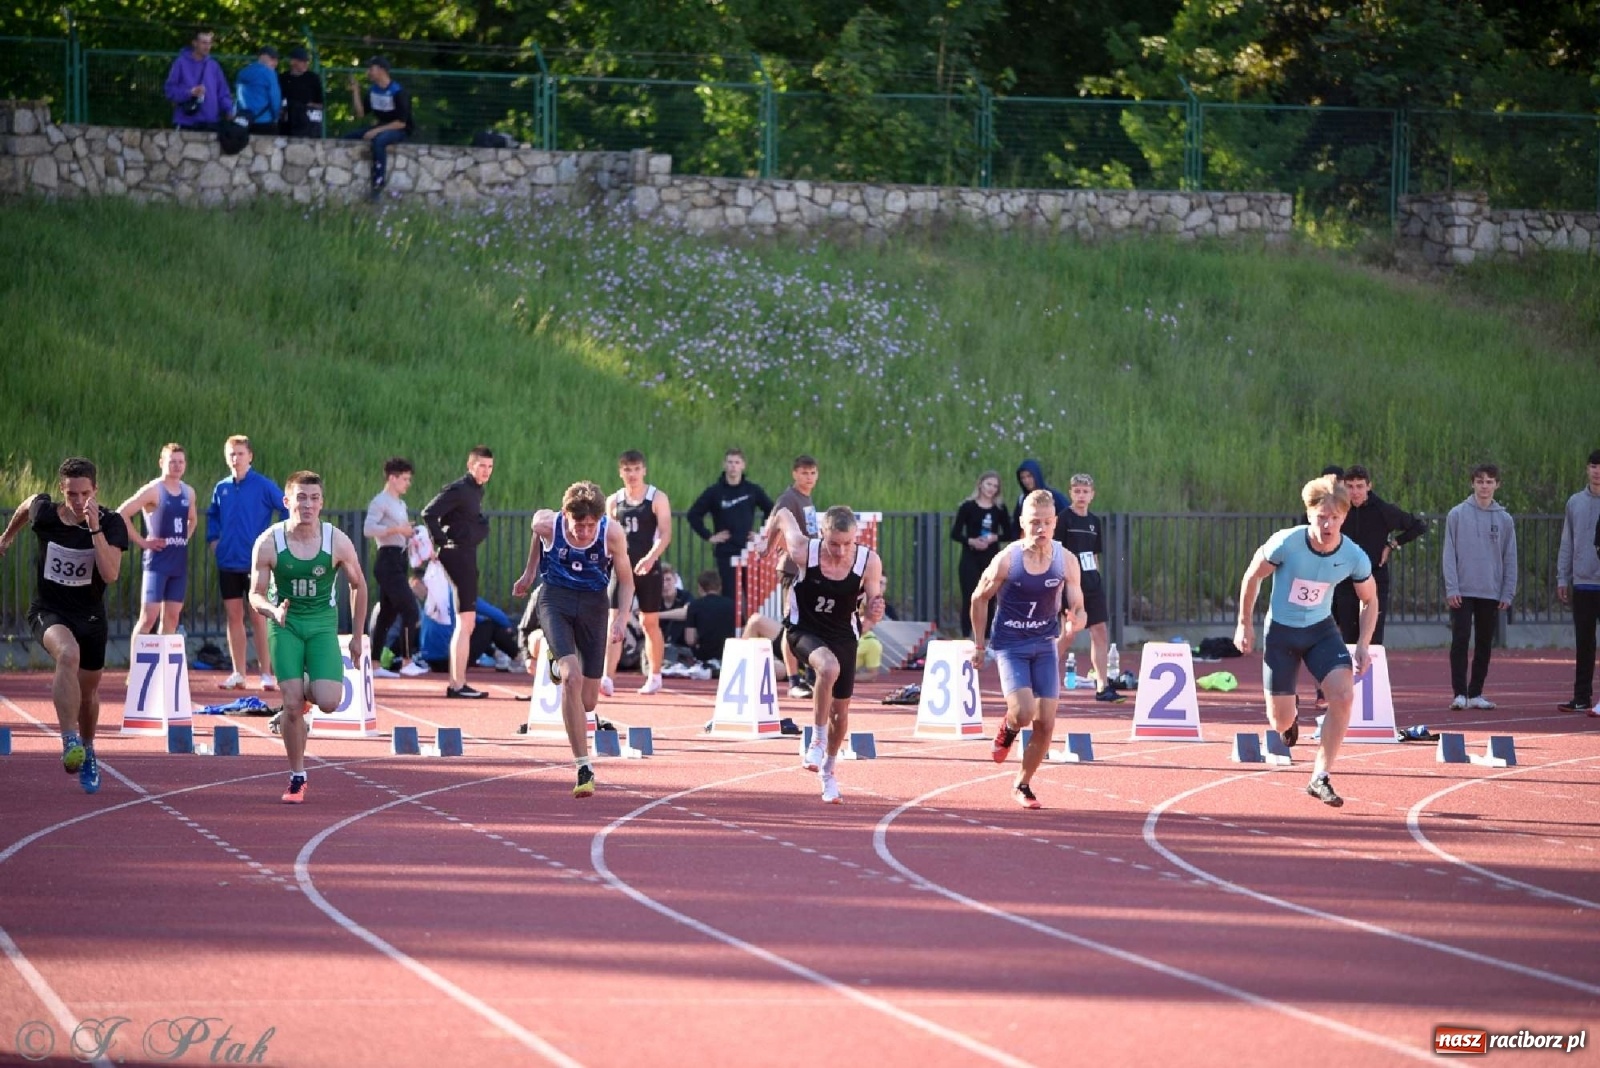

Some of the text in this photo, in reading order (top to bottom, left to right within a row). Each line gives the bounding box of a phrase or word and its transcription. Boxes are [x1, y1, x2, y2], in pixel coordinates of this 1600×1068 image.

[51, 557, 87, 577] 336
[290, 579, 317, 597] 105
[1297, 586, 1320, 602] 33
[815, 596, 835, 613] 22
[1027, 601, 1037, 618] 7
[136, 652, 160, 711] 7
[168, 653, 183, 712] 7
[364, 655, 372, 712] 6
[723, 658, 749, 715] 4
[760, 657, 774, 715] 4
[928, 660, 951, 716] 3
[962, 660, 976, 717] 3
[1148, 662, 1186, 720] 2
[1353, 663, 1373, 720] 1
